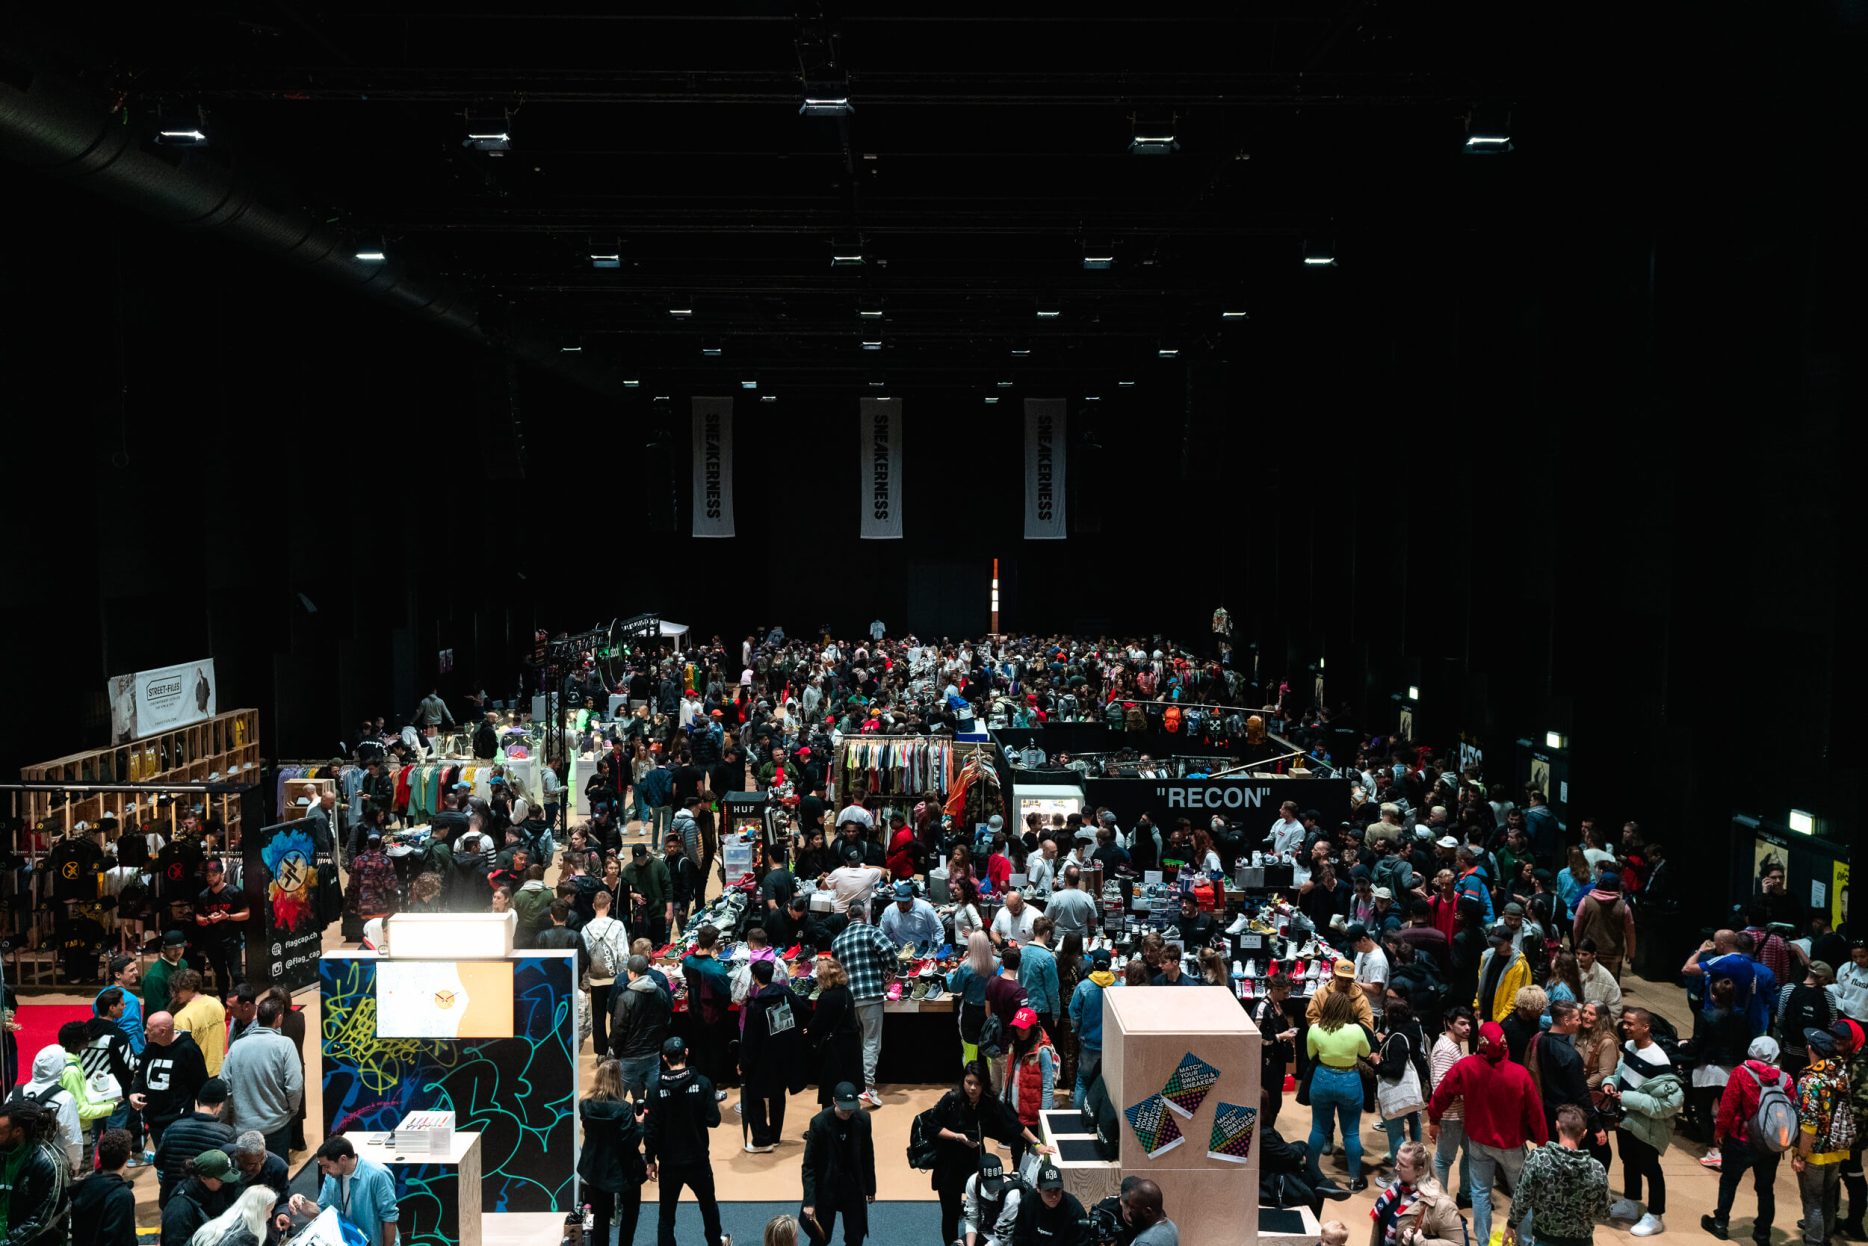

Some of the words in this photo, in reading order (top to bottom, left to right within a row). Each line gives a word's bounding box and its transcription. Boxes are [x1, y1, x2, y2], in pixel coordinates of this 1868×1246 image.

[705, 414, 720, 519] SNEAKERNESS
[874, 415, 888, 520] SNEAKERNESS
[1038, 415, 1052, 521] SNEAKERNESS
[1156, 787, 1271, 808] "RECON"
[733, 805, 755, 813] HUF
[285, 931, 318, 949] flagcap.ch
[285, 950, 321, 969] @flag_cap
[1016, 1011, 1028, 1022] M
[145, 1059, 174, 1090] G
[1179, 1064, 1203, 1073] MATCH
[1180, 1070, 1199, 1078] YOUR
[1181, 1073, 1209, 1084] SWATCH
[1135, 1105, 1145, 1128] MATCH
[1140, 1111, 1149, 1129] YOUR
[1146, 1103, 1156, 1131] SWATCH
[1216, 1108, 1238, 1124] MATCH
[1220, 1115, 1236, 1128] YOUR
[1223, 1115, 1248, 1133] SWATCH
